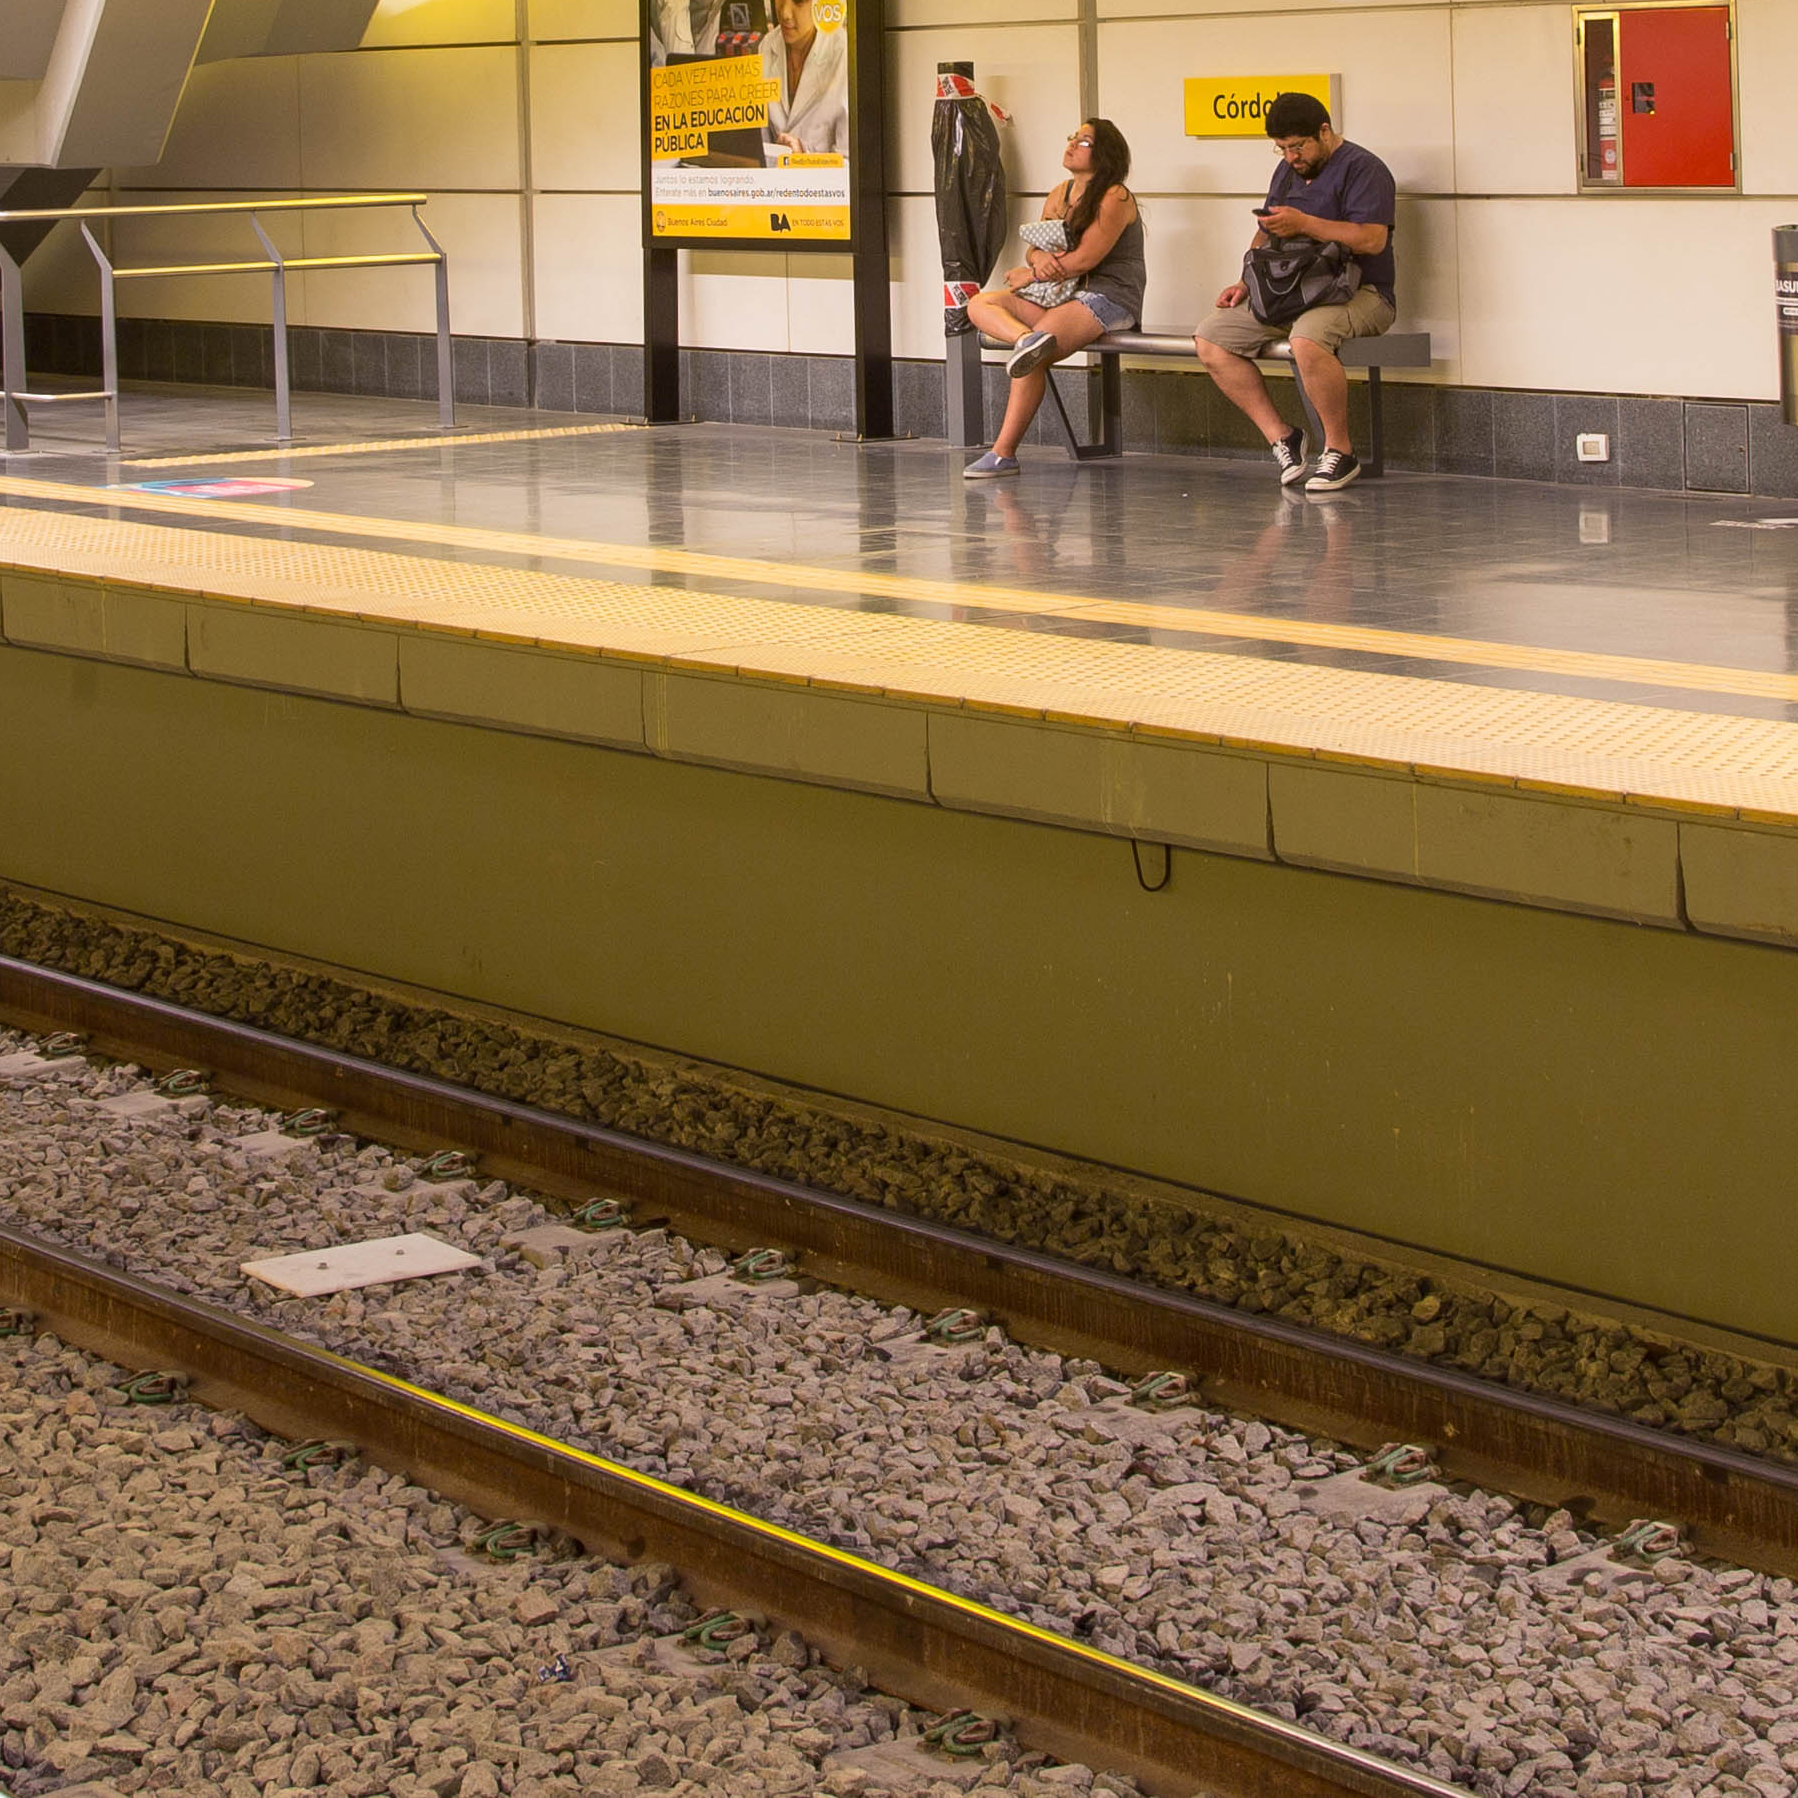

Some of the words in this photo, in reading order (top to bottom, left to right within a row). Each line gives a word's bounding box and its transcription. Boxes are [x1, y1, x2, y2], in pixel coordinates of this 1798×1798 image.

[813, 3, 842, 23] VOS
[653, 70, 683, 90] CADA
[684, 67, 707, 85] VEZ
[709, 64, 734, 83] HAY
[654, 89, 704, 110] RAZONES
[706, 86, 736, 104] PARA
[739, 81, 779, 101] CREER
[1213, 91, 1281, 120] Córdo
[655, 114, 670, 132] EN
[673, 112, 688, 130] LA
[690, 100, 765, 128] EDUCACIÓN
[655, 131, 705, 153] PÚBLICA
[707, 187, 845, 200] buenosaires.gob.ar/redentodoestasvos
[667, 217, 689, 227] Buenos
[690, 217, 705, 227] Aires
[706, 217, 728, 227] Ciudad
[770, 213, 791, 233] BA
